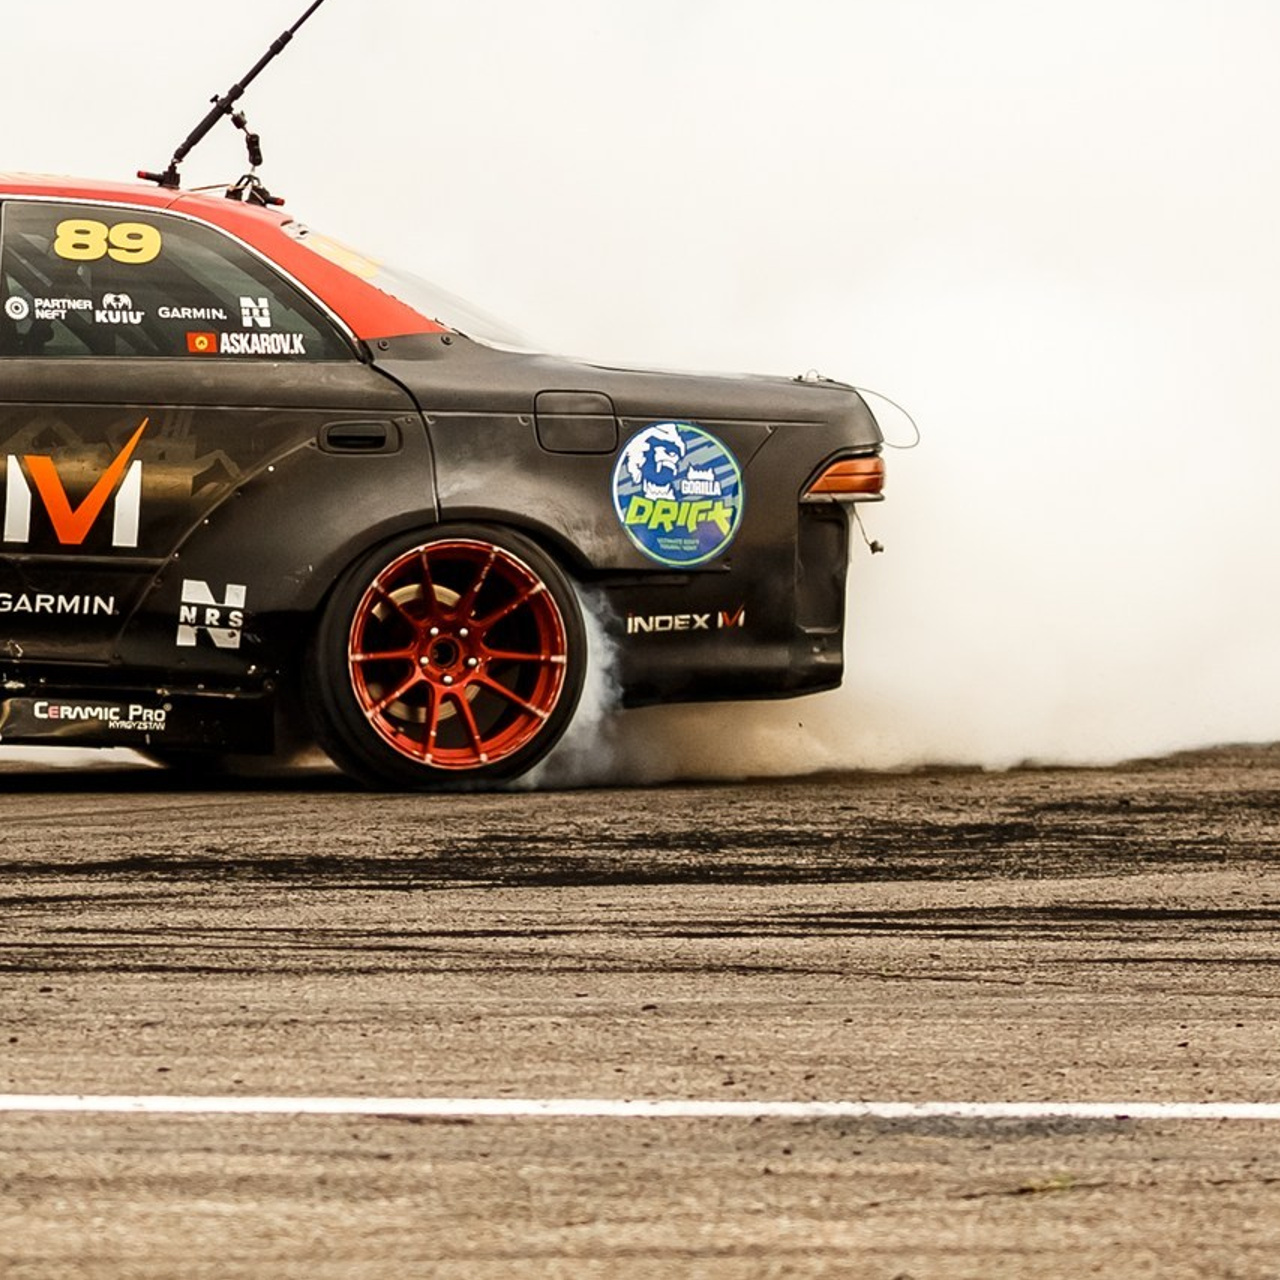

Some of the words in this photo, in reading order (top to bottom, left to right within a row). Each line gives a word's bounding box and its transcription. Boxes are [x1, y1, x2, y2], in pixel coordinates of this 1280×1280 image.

[54, 219, 162, 264] 89
[34, 298, 93, 310] PARTNER
[35, 308, 67, 320] NEFT
[95, 310, 142, 325] KUIU
[220, 332, 306, 355] ASKAROV.K
[681, 480, 722, 496] GORILLA
[178, 604, 245, 628] NRS
[108, 720, 166, 731] KYRGYZSTAN
